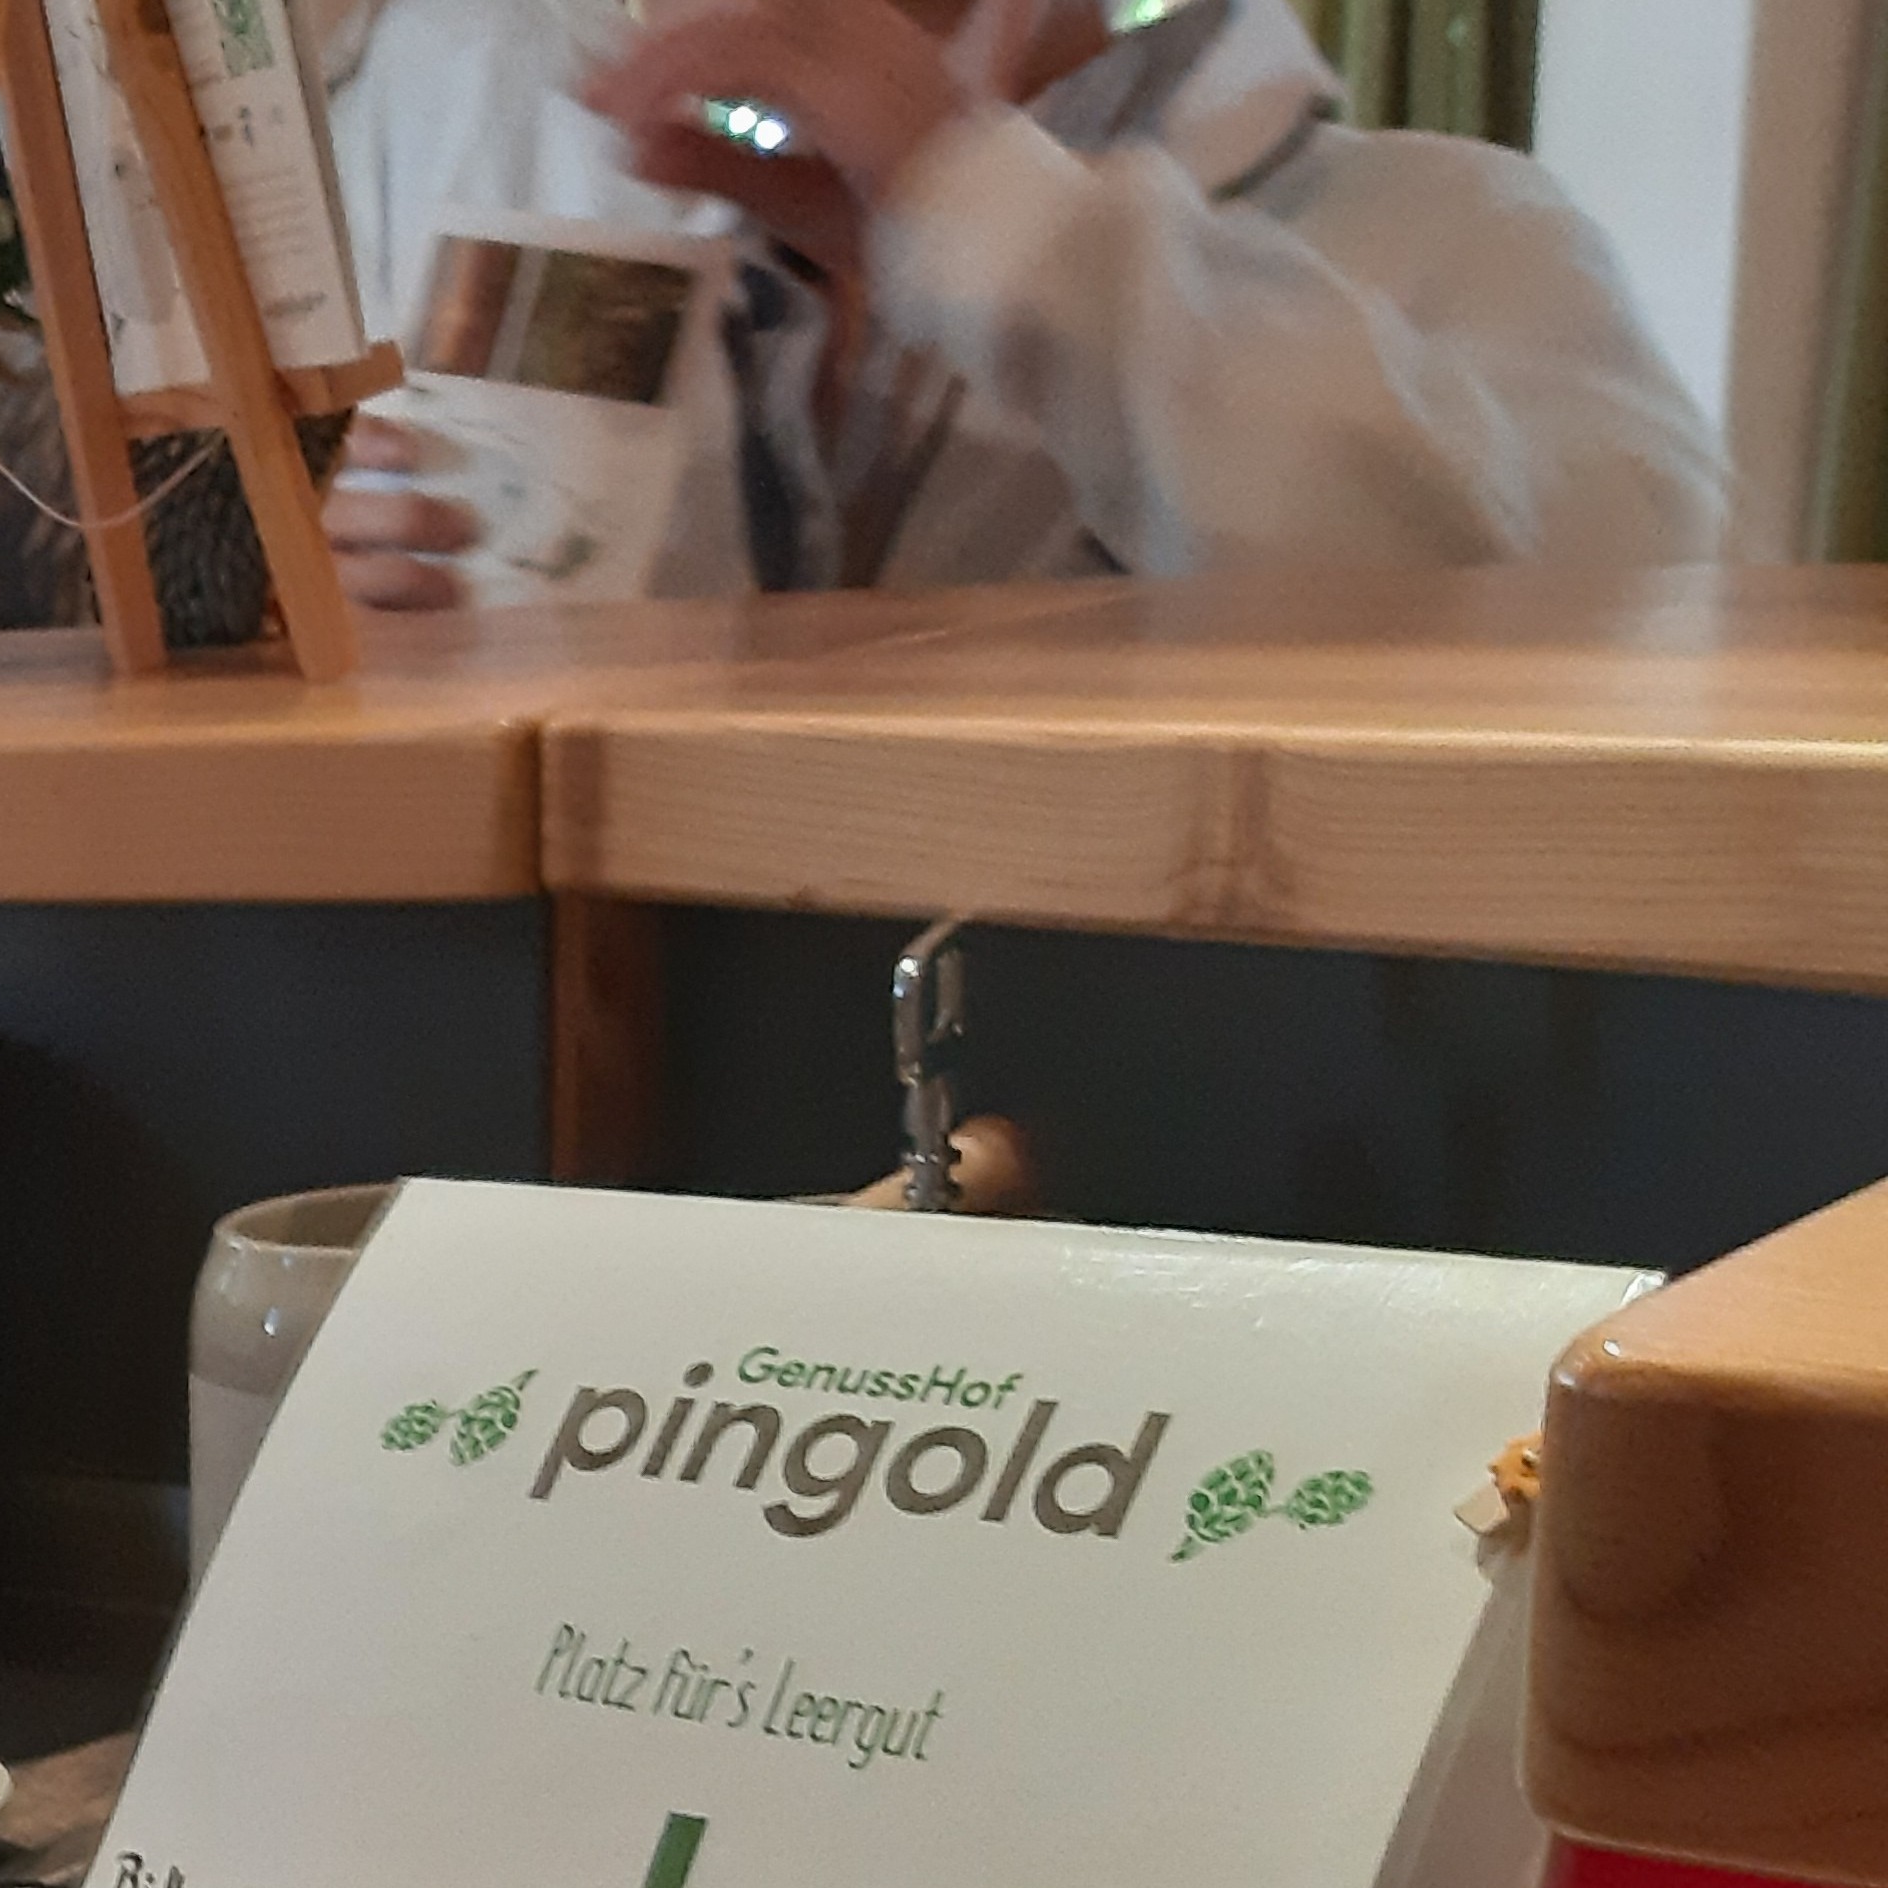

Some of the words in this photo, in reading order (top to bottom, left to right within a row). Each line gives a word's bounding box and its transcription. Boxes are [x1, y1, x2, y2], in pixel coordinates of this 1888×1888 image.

[528, 1360, 1174, 1539] pingold
[737, 1346, 1022, 1410] GenussHof
[534, 1621, 648, 1712] Platz
[762, 1658, 944, 1770] Leergut
